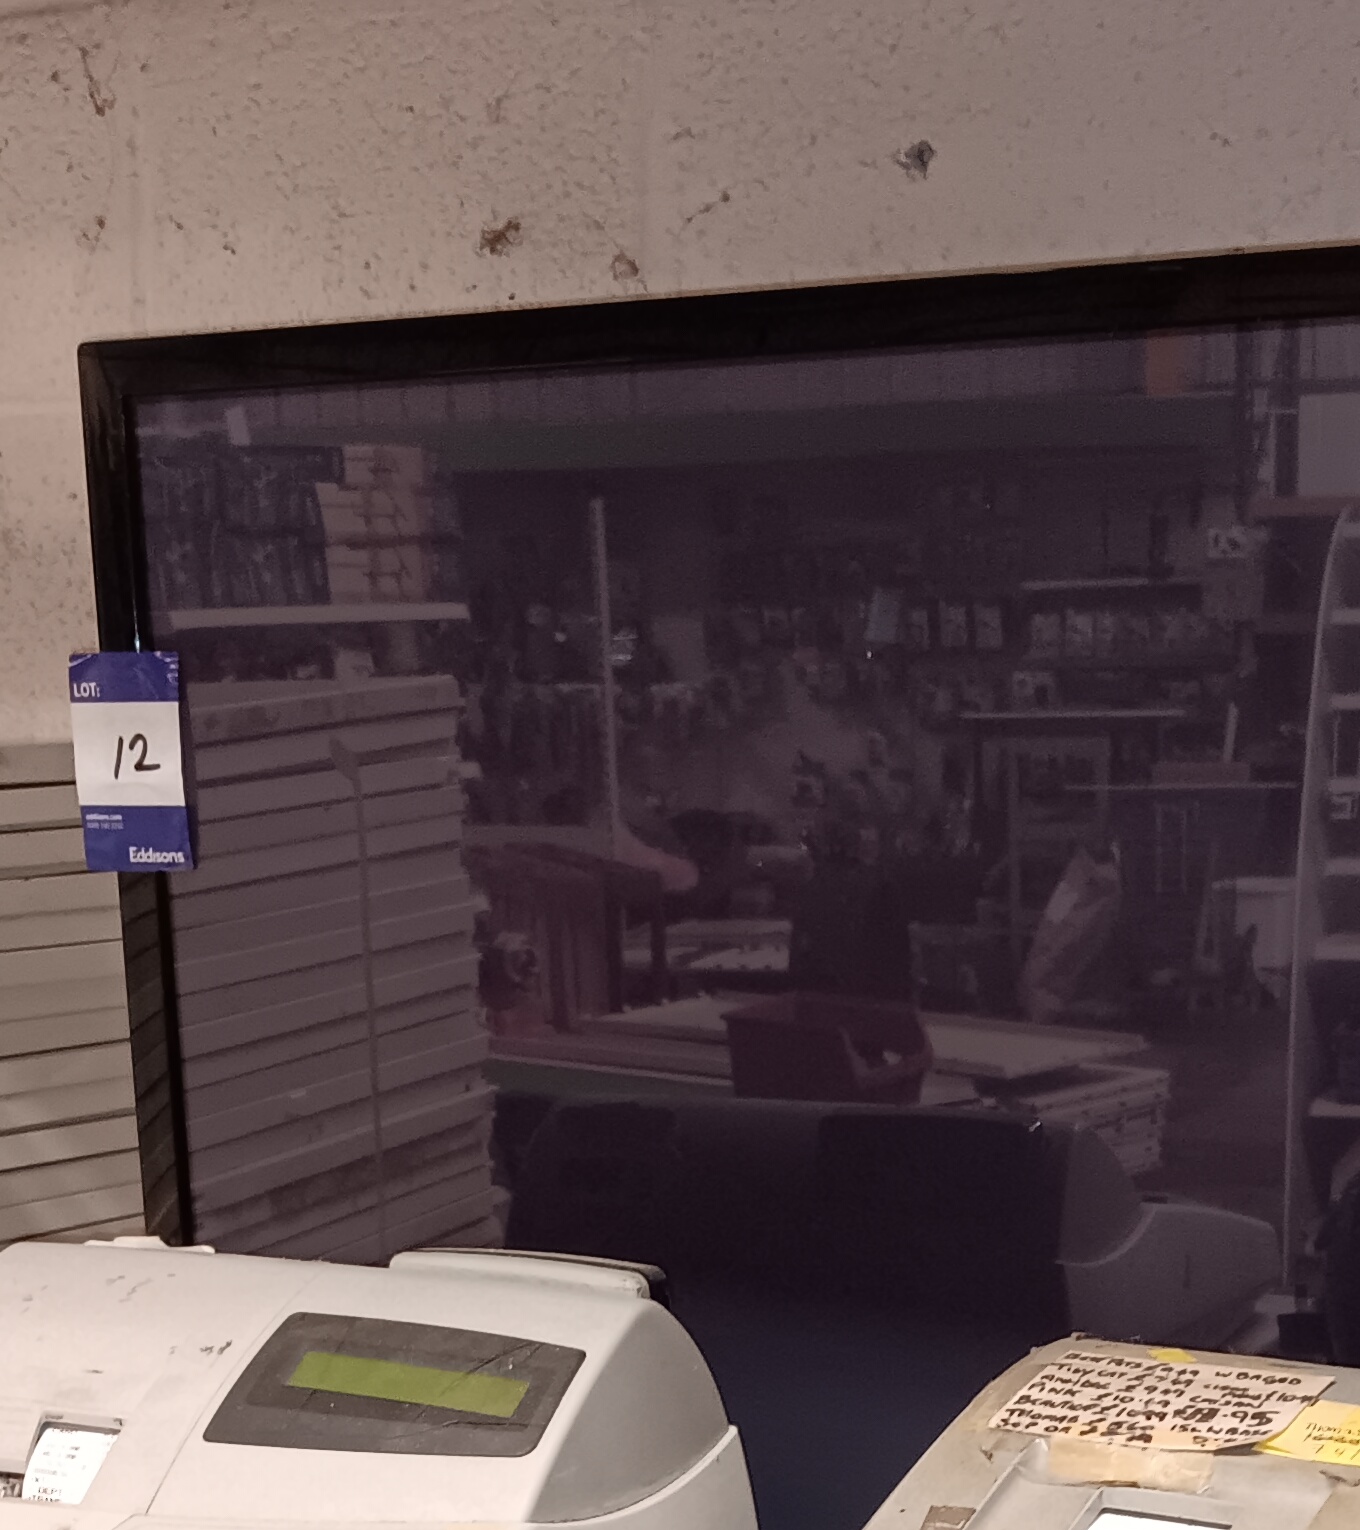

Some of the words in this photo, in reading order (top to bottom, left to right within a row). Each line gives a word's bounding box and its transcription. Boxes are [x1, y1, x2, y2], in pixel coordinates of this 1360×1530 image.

[73, 682, 100, 698] LOT:
[114, 733, 161, 779] 12
[129, 846, 185, 864] Eddisons
